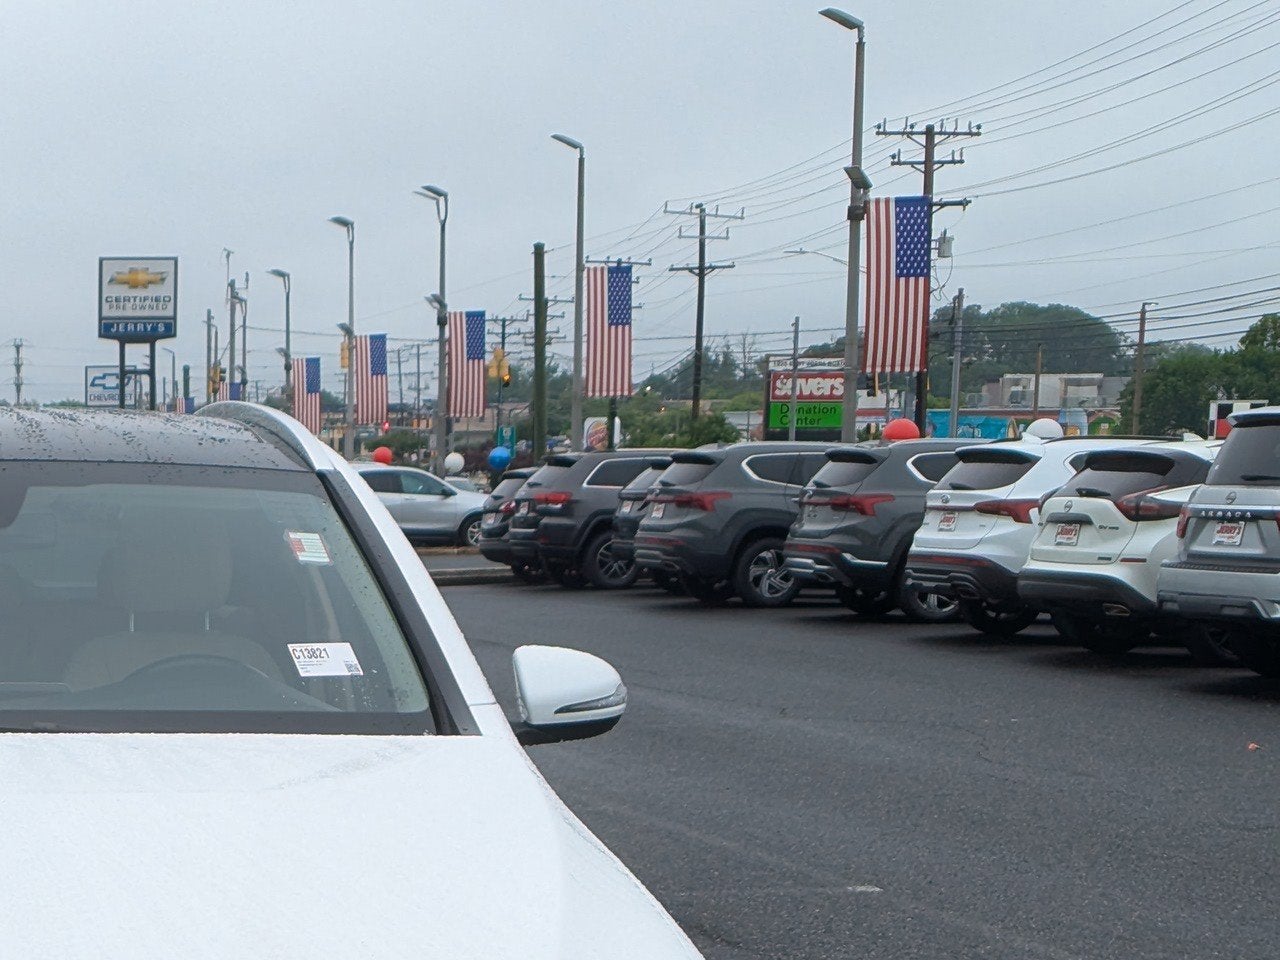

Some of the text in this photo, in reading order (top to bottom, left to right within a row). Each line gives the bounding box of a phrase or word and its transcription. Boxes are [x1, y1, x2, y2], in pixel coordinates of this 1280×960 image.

[105, 295, 172, 304] CERTIFIED
[110, 322, 166, 333] JERRY'S
[89, 393, 133, 402] CHEVROET
[780, 403, 837, 415] Dnation
[779, 415, 822, 426] Cnter
[291, 647, 330, 660] C13821
